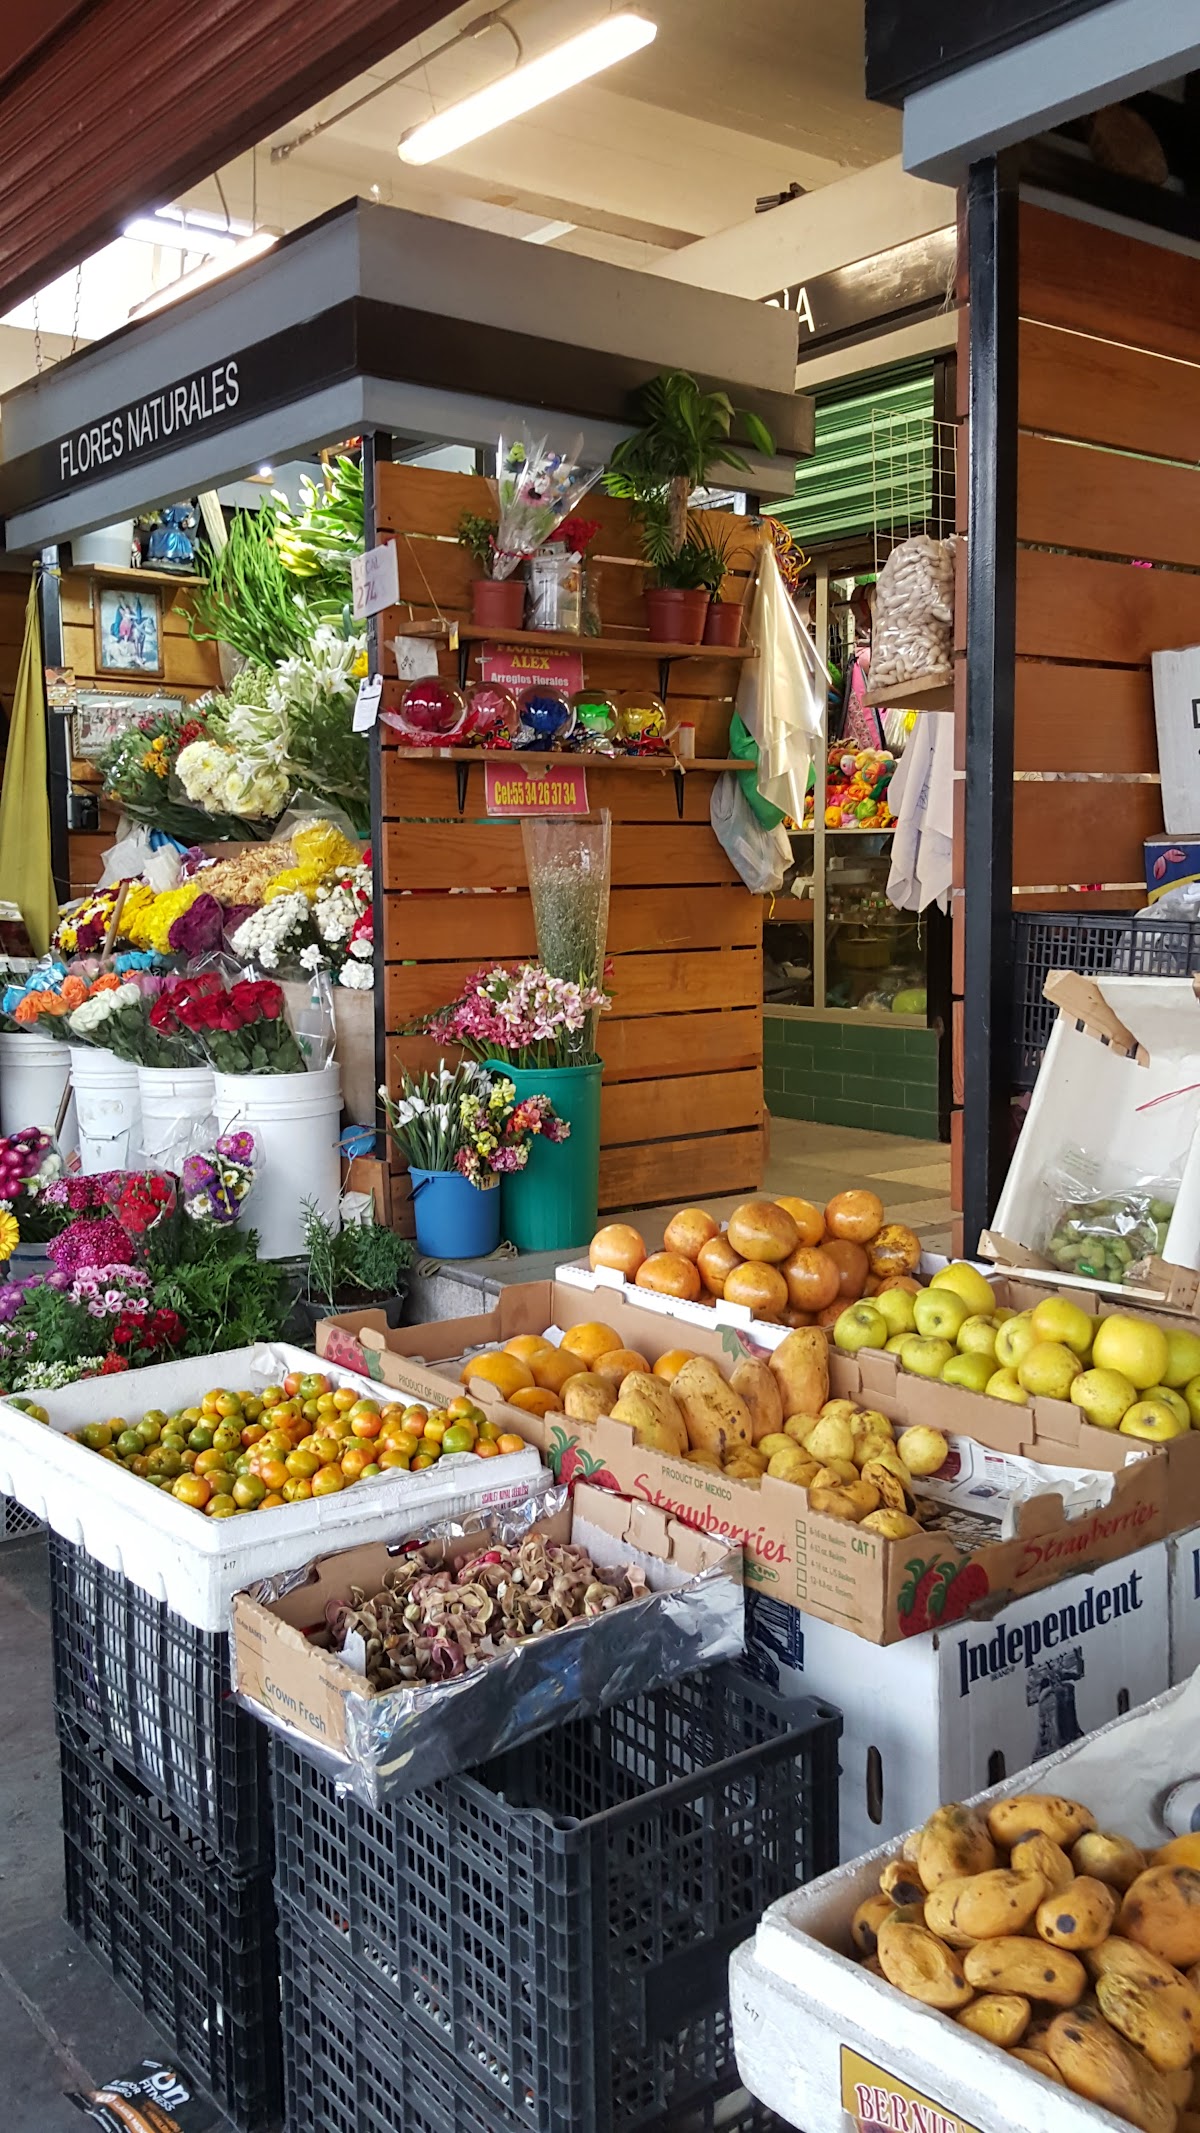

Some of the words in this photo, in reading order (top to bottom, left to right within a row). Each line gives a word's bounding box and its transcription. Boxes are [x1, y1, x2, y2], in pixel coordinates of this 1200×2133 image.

[60, 417, 124, 480] FLORES
[128, 361, 240, 451] NATURALES
[491, 672, 531, 684] Arreglos
[532, 675, 569, 686] Florales
[511, 655, 550, 669] ALEX
[525, 782, 537, 805] 34
[538, 782, 550, 805] 26
[551, 782, 561, 805] 37
[563, 783, 576, 805] 34
[399, 1374, 423, 1394] PRODUCT
[662, 1466, 693, 1487] PRODUCT
[695, 1478, 704, 1490] OF
[705, 1482, 732, 1501] MEXICO
[634, 1473, 791, 1563] Strawberries
[851, 1537, 869, 1556] CAT
[1015, 1501, 1159, 1578] Strawberries
[958, 1569, 1143, 1697] Independent
[265, 1676, 297, 1711] Grown
[299, 1703, 326, 1734] Fresh
[139, 2079, 175, 2112] FITNESS
